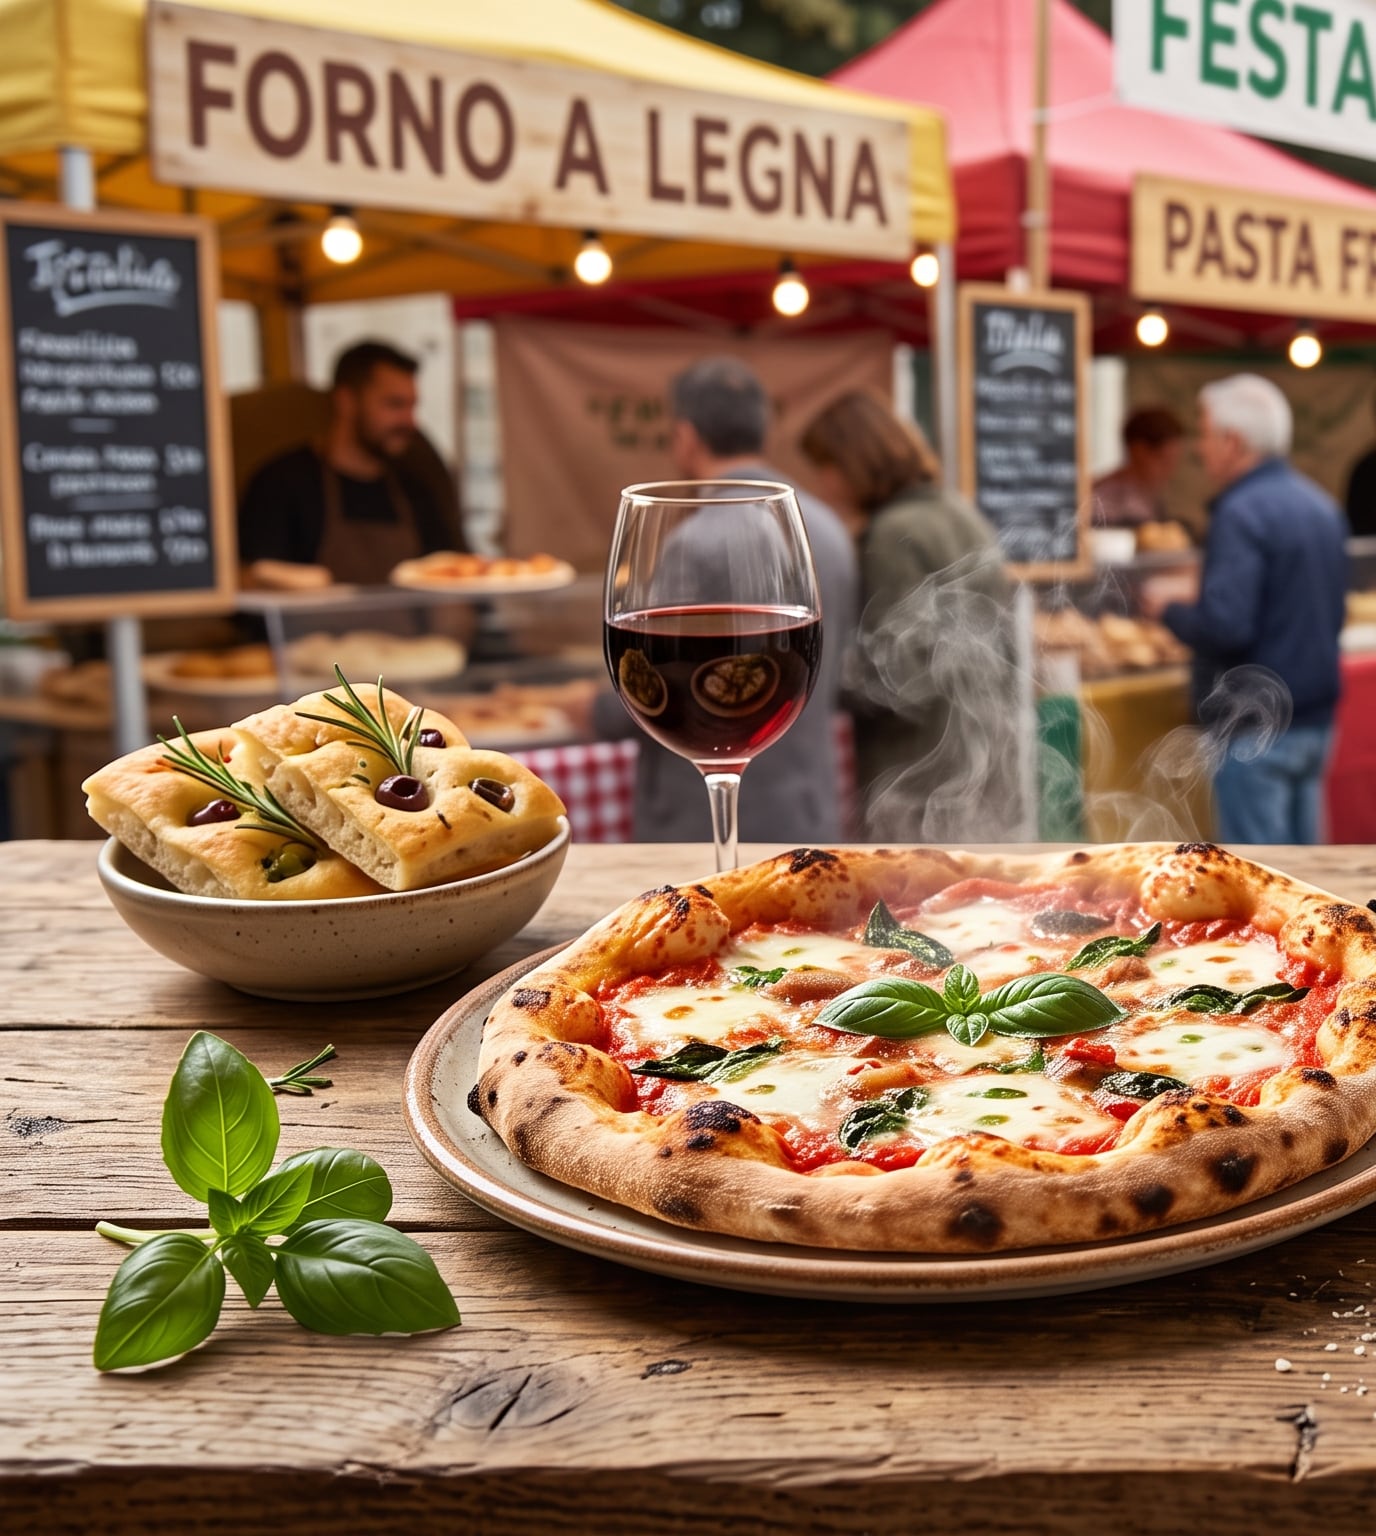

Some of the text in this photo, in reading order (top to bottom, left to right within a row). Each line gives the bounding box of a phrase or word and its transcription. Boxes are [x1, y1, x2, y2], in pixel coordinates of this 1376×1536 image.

[185, 38, 889, 227] FORNO A LEGNA
[1163, 201, 1321, 292] PASTA
